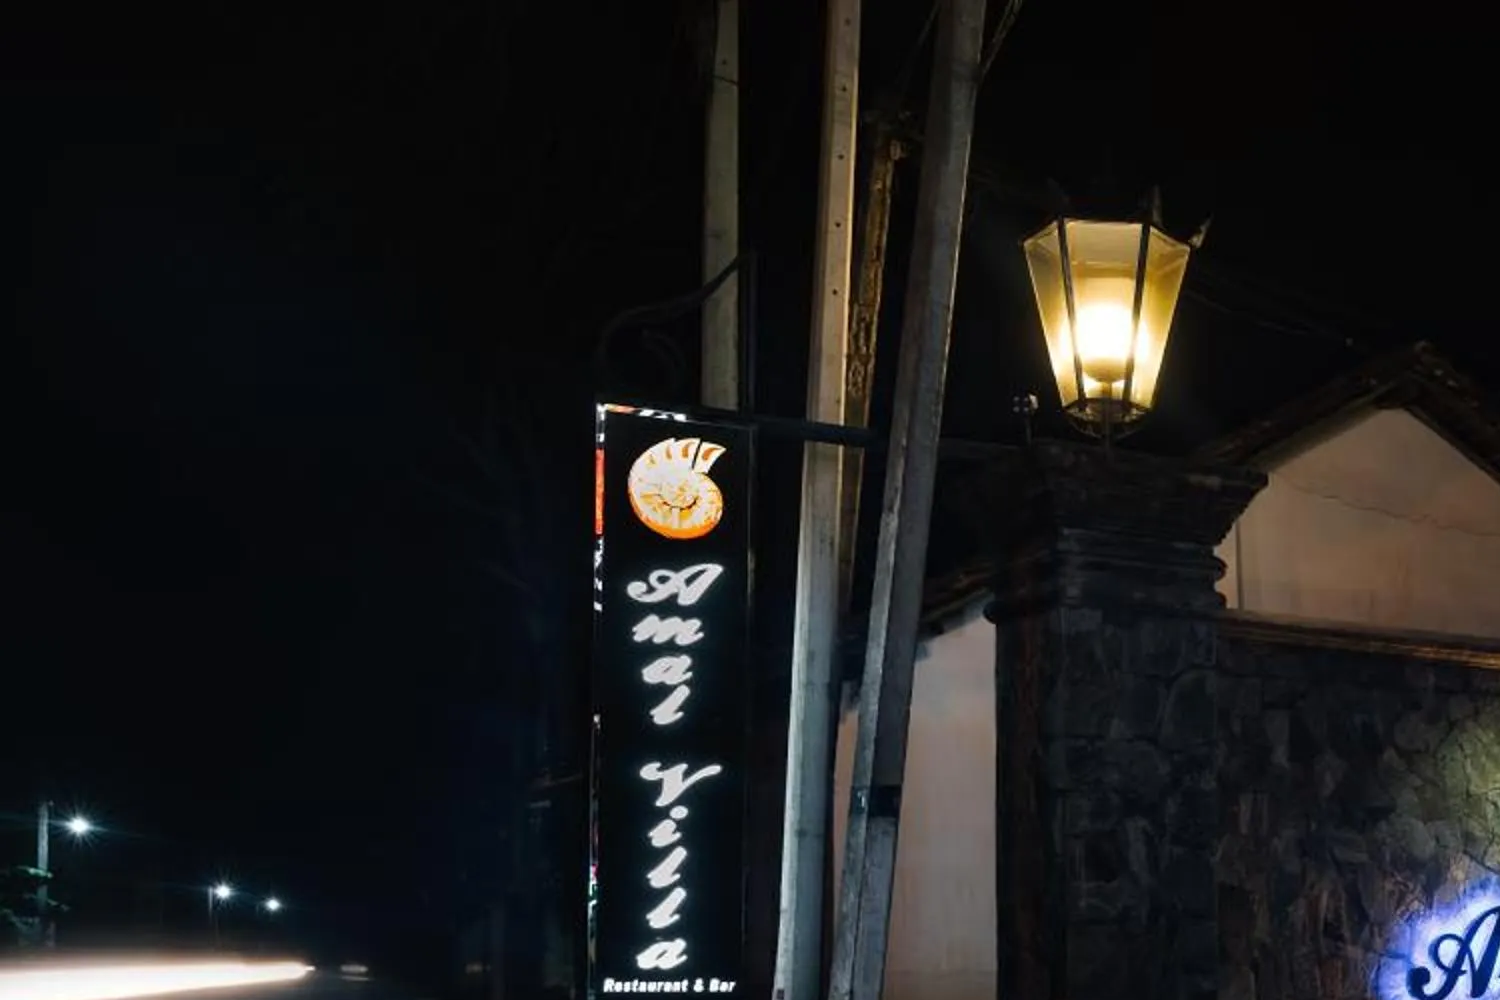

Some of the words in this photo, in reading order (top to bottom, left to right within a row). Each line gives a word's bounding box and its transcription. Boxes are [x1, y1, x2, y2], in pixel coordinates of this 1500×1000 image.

[627, 562, 724, 725] Amal
[635, 761, 722, 970] Villa
[603, 978, 688, 993] Restaurant
[693, 978, 705, 993] &
[709, 978, 736, 993] Bar
